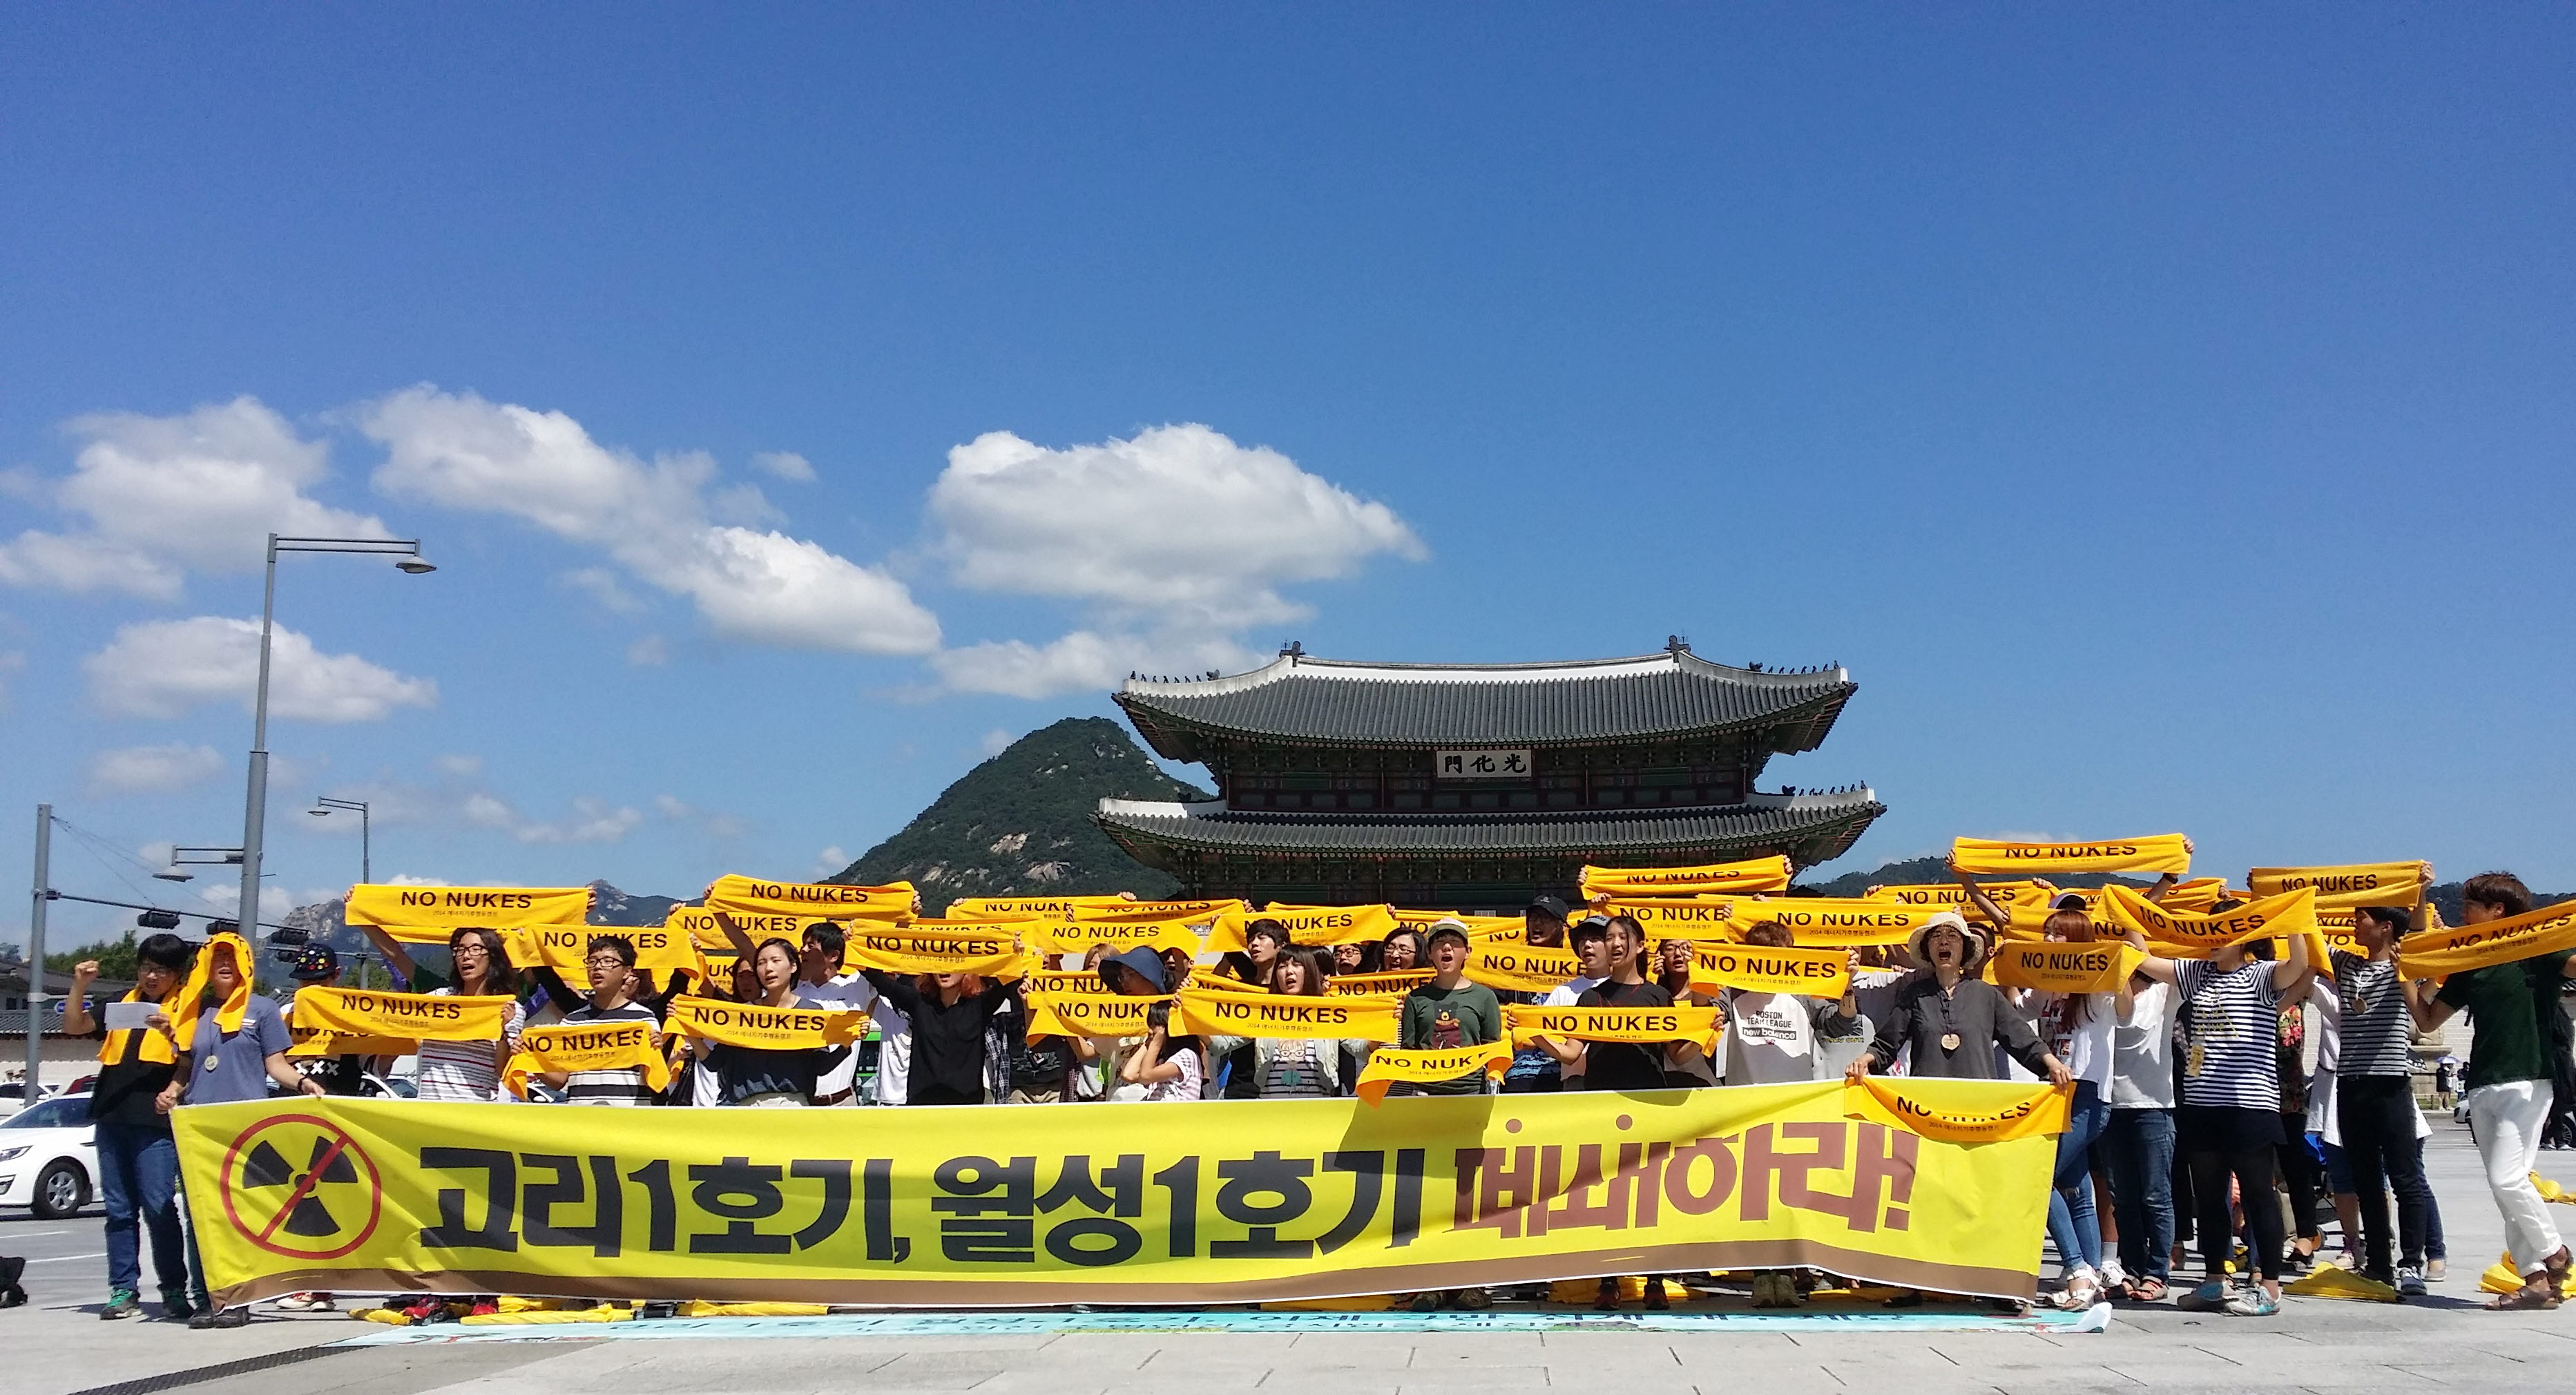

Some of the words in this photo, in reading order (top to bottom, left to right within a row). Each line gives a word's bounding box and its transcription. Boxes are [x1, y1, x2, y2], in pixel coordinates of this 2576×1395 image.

[2005, 848, 2040, 858] NO
[2050, 846, 2137, 857] NUKES
[1627, 874, 1656, 884] NO
[1665, 871, 1740, 881] NUKES
[2281, 878, 2307, 893] NO
[2312, 874, 2377, 892] NUKES
[401, 892, 436, 906] NO
[446, 892, 532, 909] NUKES
[751, 884, 782, 899] NO
[791, 887, 868, 903] NUKES
[1896, 892, 1928, 904] NO
[1938, 889, 2015, 903] NUES
[1021, 903, 1073, 912] NUKE
[1619, 908, 1653, 921] NO
[1662, 907, 1724, 921] NUKE
[684, 916, 714, 930] NO
[731, 916, 797, 931] UKES
[1282, 914, 1352, 930] NUKES
[1777, 912, 1811, 925] NO
[1822, 914, 1909, 926] NUKES
[2140, 906, 2166, 929] NO
[2172, 914, 2265, 936] NUKES
[544, 932, 577, 947] NO
[1052, 927, 1081, 939] NO
[1088, 926, 1160, 938] NUKES
[1489, 931, 1519, 942] NO
[2447, 934, 2482, 951] NO
[2489, 913, 2573, 941] NUKES
[866, 936, 901, 951] NO
[912, 939, 999, 955] NUKES
[1484, 954, 1516, 970] NO
[1525, 958, 1586, 976] NUKE
[1700, 954, 1736, 972] NO
[1747, 958, 1836, 978] NUKES
[2021, 952, 2044, 969] NO
[2049, 953, 2108, 971] NUKES
[1032, 978, 1064, 992] NO
[1338, 983, 1367, 996] NO
[341, 994, 374, 1012] NO
[382, 999, 461, 1019] NUKES
[1058, 1002, 1090, 1018] NO
[1098, 1003, 1153, 1019] NUK
[1215, 1002, 1251, 1019] NO
[1260, 1006, 1348, 1023] NUKES
[694, 1008, 729, 1026] NO
[739, 1012, 825, 1031] NUKES
[1542, 1016, 1577, 1032] NO
[1588, 1016, 1678, 1032] NUKES
[522, 1036, 552, 1052] NO
[562, 1029, 643, 1051] NUKES
[1743, 1028, 1760, 1037] new
[1376, 1055, 1411, 1068] NO
[1897, 1096, 1932, 1117] NO
[421, 1147, 910, 1264] 고리1호기,
[931, 1148, 1425, 1266] 월성1호기
